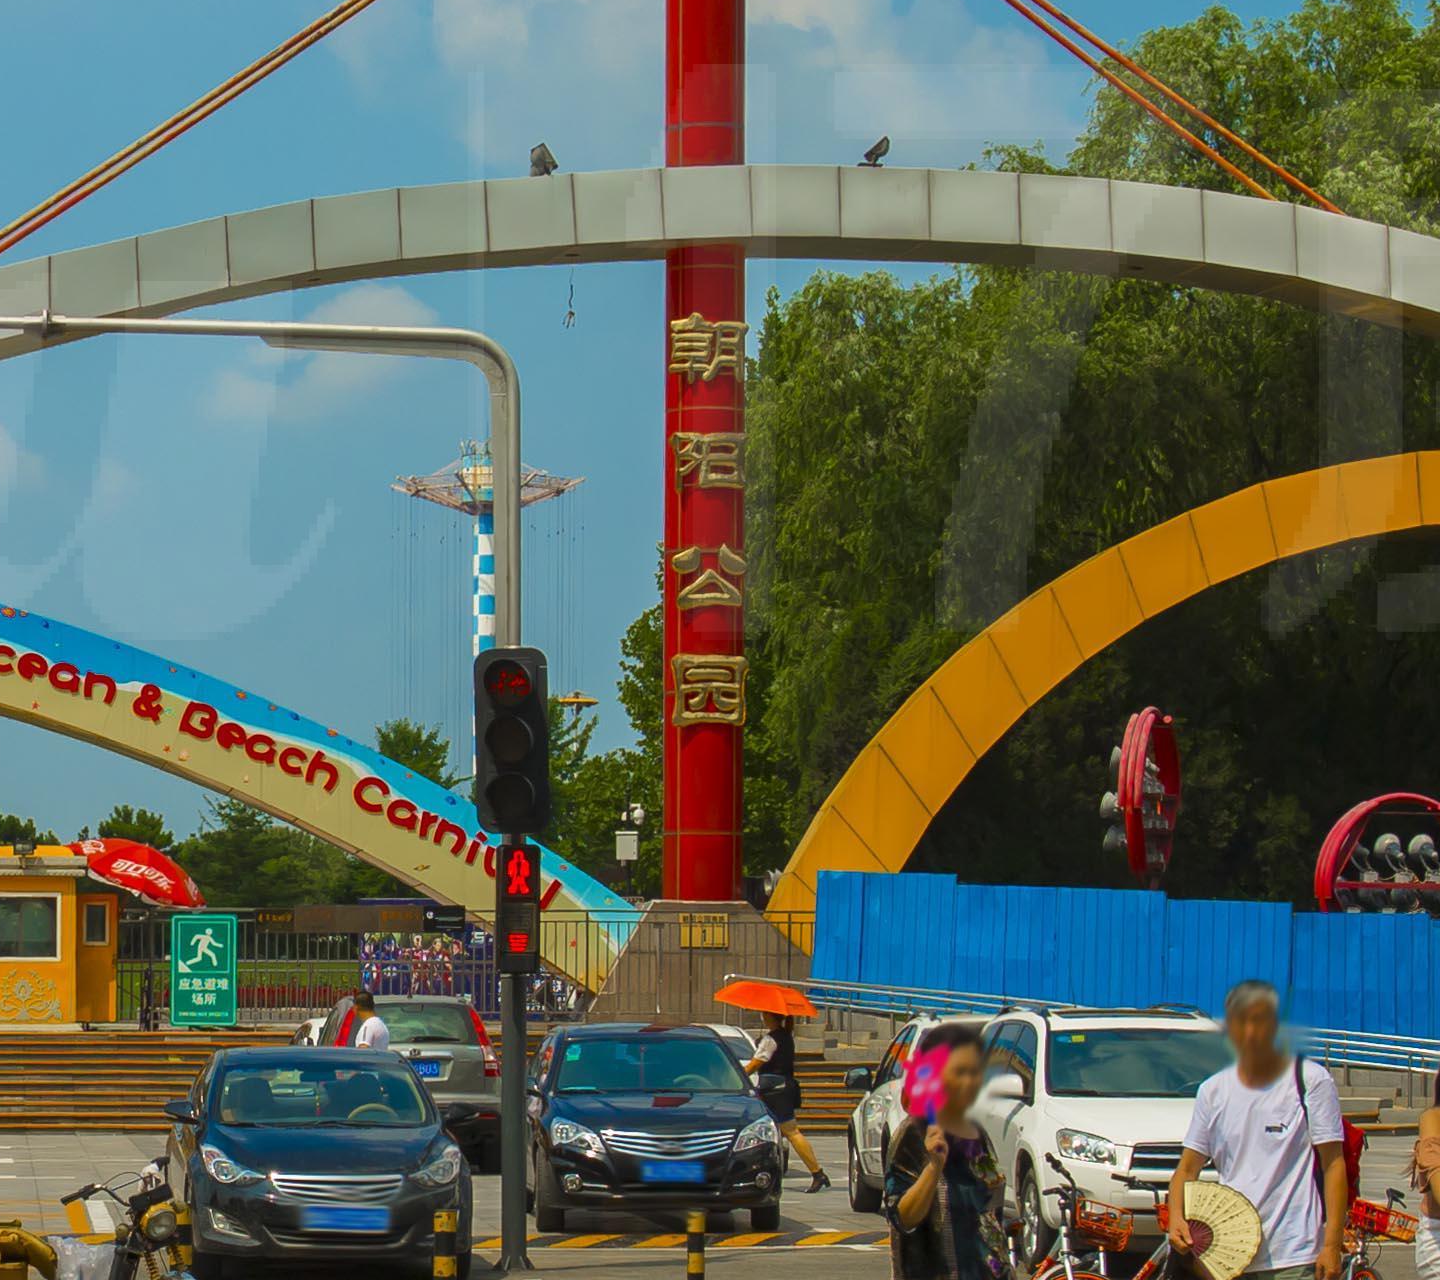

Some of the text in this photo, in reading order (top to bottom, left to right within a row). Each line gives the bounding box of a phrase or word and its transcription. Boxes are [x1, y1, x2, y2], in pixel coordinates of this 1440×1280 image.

[667, 311, 749, 728] 朝阳公园
[132, 682, 167, 723] &
[178, 699, 341, 795] Beach
[178, 977, 229, 991] 应急避难
[191, 992, 217, 1006] 场所
